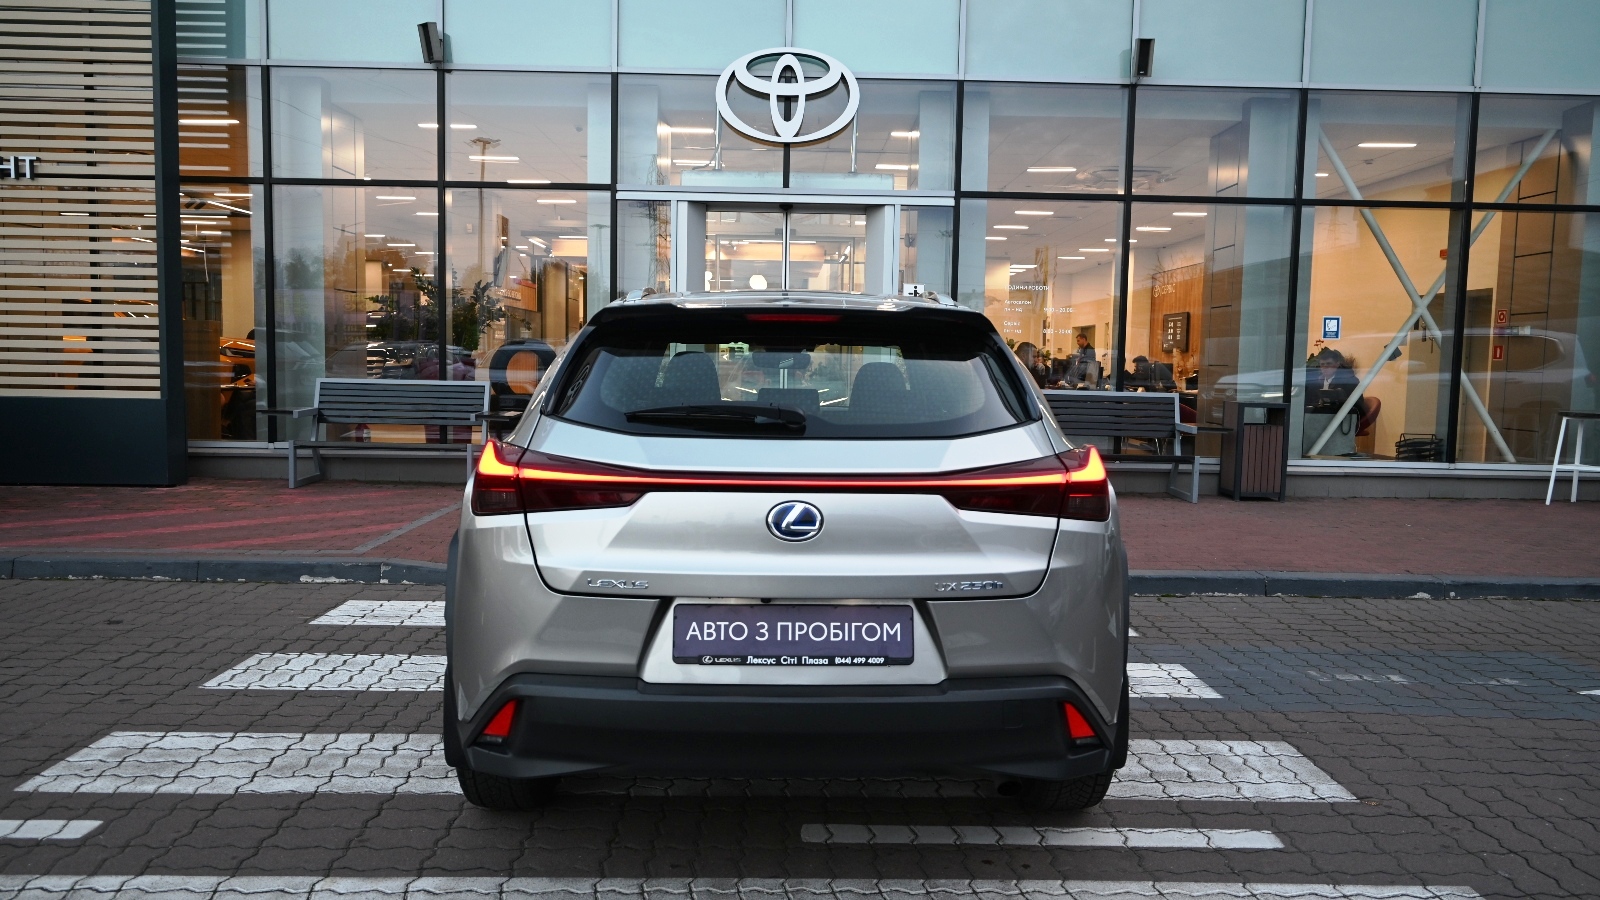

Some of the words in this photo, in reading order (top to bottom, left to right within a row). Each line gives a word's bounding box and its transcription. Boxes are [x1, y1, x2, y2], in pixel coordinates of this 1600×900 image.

[587, 578, 649, 590] LEXUS
[935, 582, 957, 592] UX
[960, 580, 1003, 590] 250h
[686, 621, 748, 641] АВТО
[777, 622, 901, 642] ПРОБІГОМ
[746, 655, 776, 665] Лексус
[780, 655, 798, 665] Сіті
[801, 656, 829, 665] Плаза
[834, 656, 852, 665] (044)
